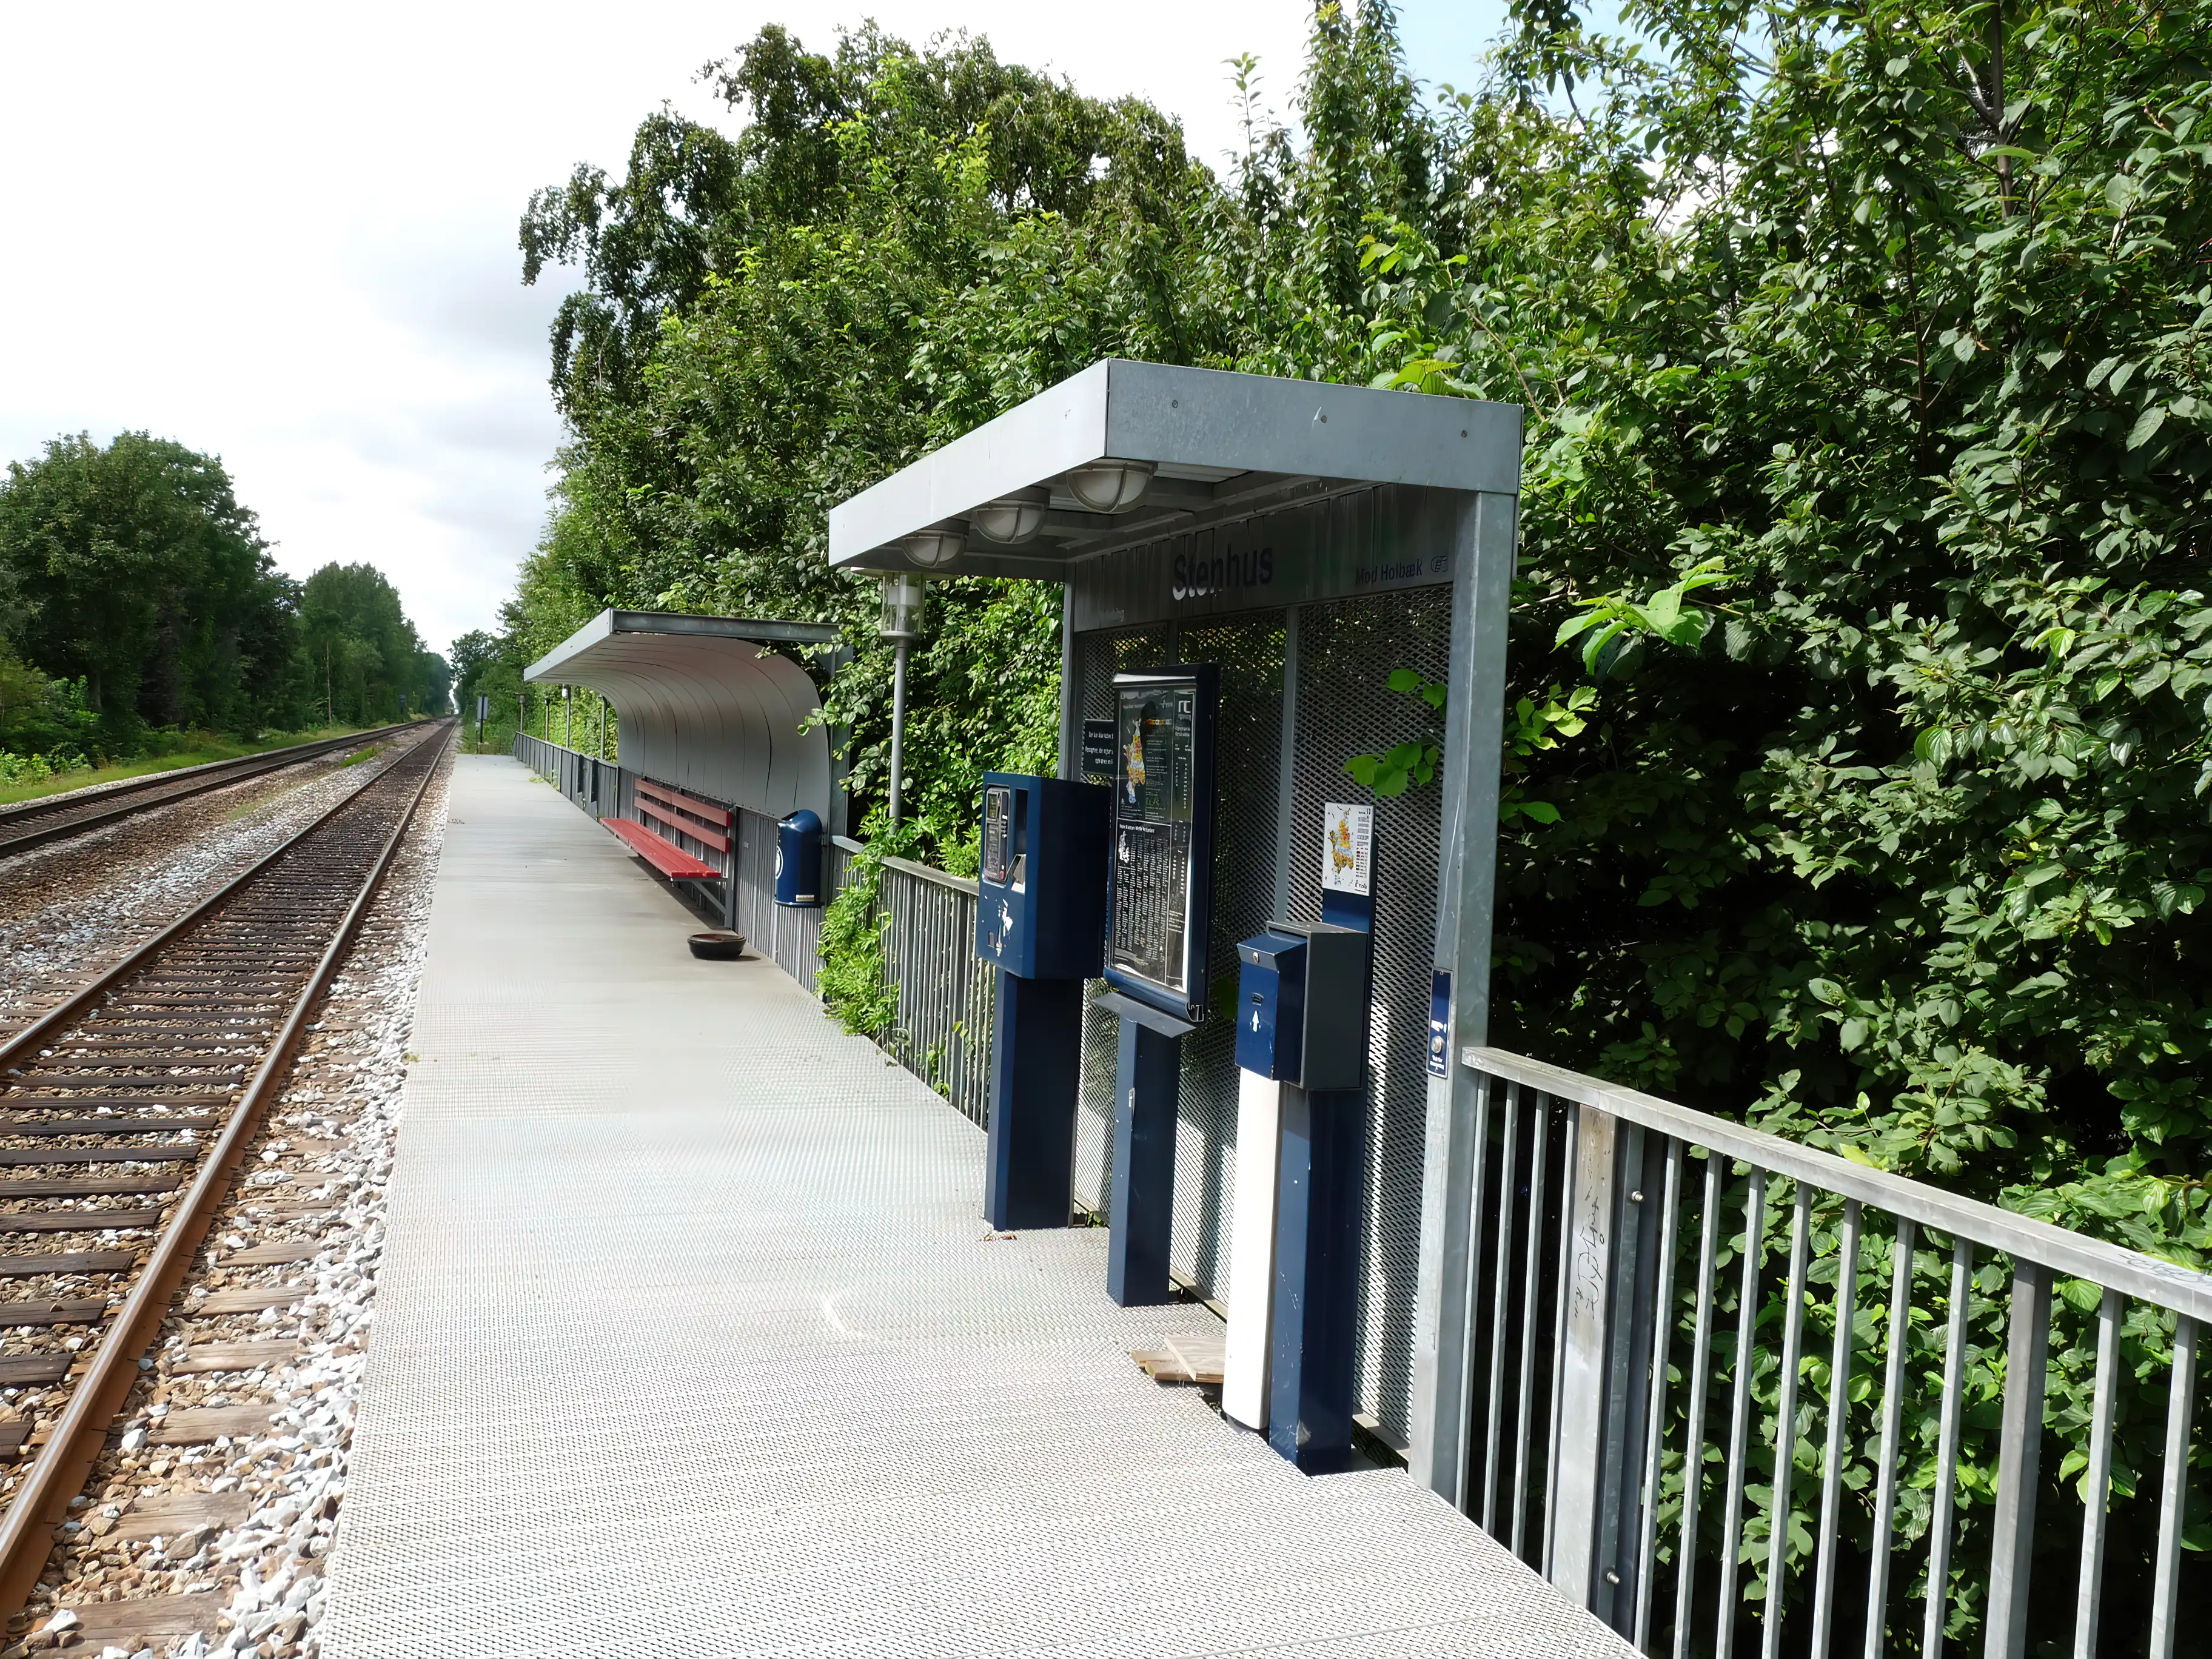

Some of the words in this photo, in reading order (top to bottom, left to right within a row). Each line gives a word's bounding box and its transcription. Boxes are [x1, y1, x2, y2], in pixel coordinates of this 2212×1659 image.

[1173, 543, 1273, 600] Stenhus
[1355, 565, 1378, 586] Mod
[1381, 557, 1423, 581] Holbæk
